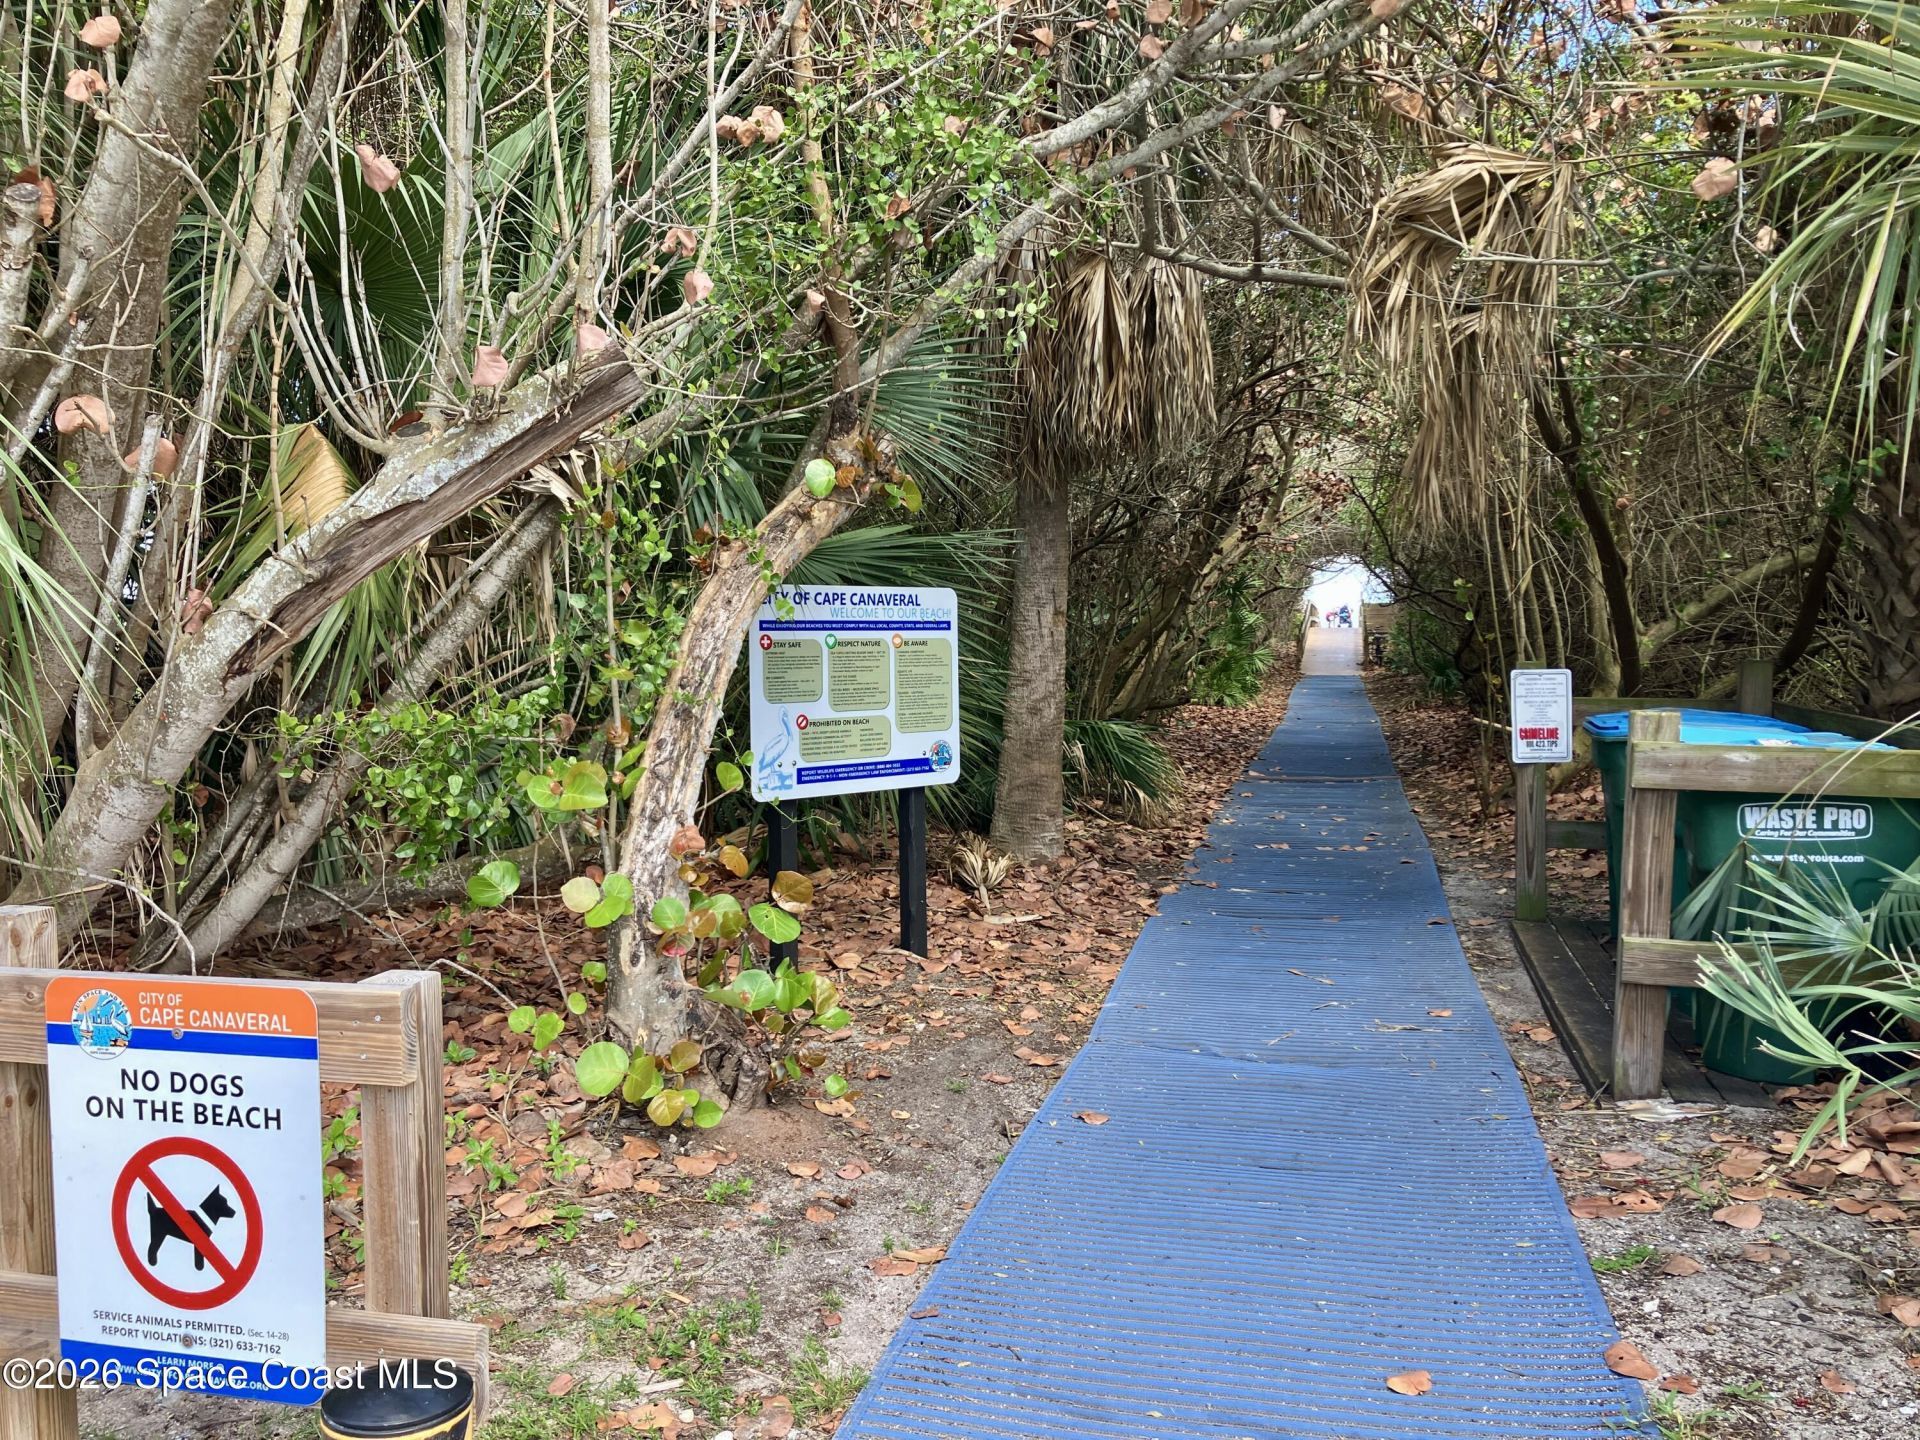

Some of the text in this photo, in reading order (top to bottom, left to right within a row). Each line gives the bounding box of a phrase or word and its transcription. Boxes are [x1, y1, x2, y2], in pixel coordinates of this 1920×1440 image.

[793, 592, 811, 605] OF
[814, 592, 847, 606] CAPE
[850, 593, 921, 607] CANAVERAL
[830, 607, 951, 619] WELCOME TO OUR BEACH!
[809, 719, 841, 727] PROHIBITED
[1744, 806, 1867, 829] WASTE PRO
[1755, 829, 1779, 838] Caring
[1808, 829, 1856, 837] Communities
[74, 1000, 83, 1012] SUN
[83, 989, 102, 999] SPACE
[105, 991, 118, 1001] AND
[139, 992, 183, 1006] CITY OF
[140, 1007, 292, 1032] CAPE CANAVERAL
[120, 1068, 244, 1097] NO DOGS
[86, 1095, 281, 1130] ON THE BEACH
[93, 1310, 290, 1341] SERVICE ANIMALS PERMITTED. (Sec. 14-28)
[102, 1325, 281, 1354] REPORT VIOLATINS: (321) 633-7162
[157, 1356, 186, 1366] LEARN
[188, 1359, 214, 1369] MORE
